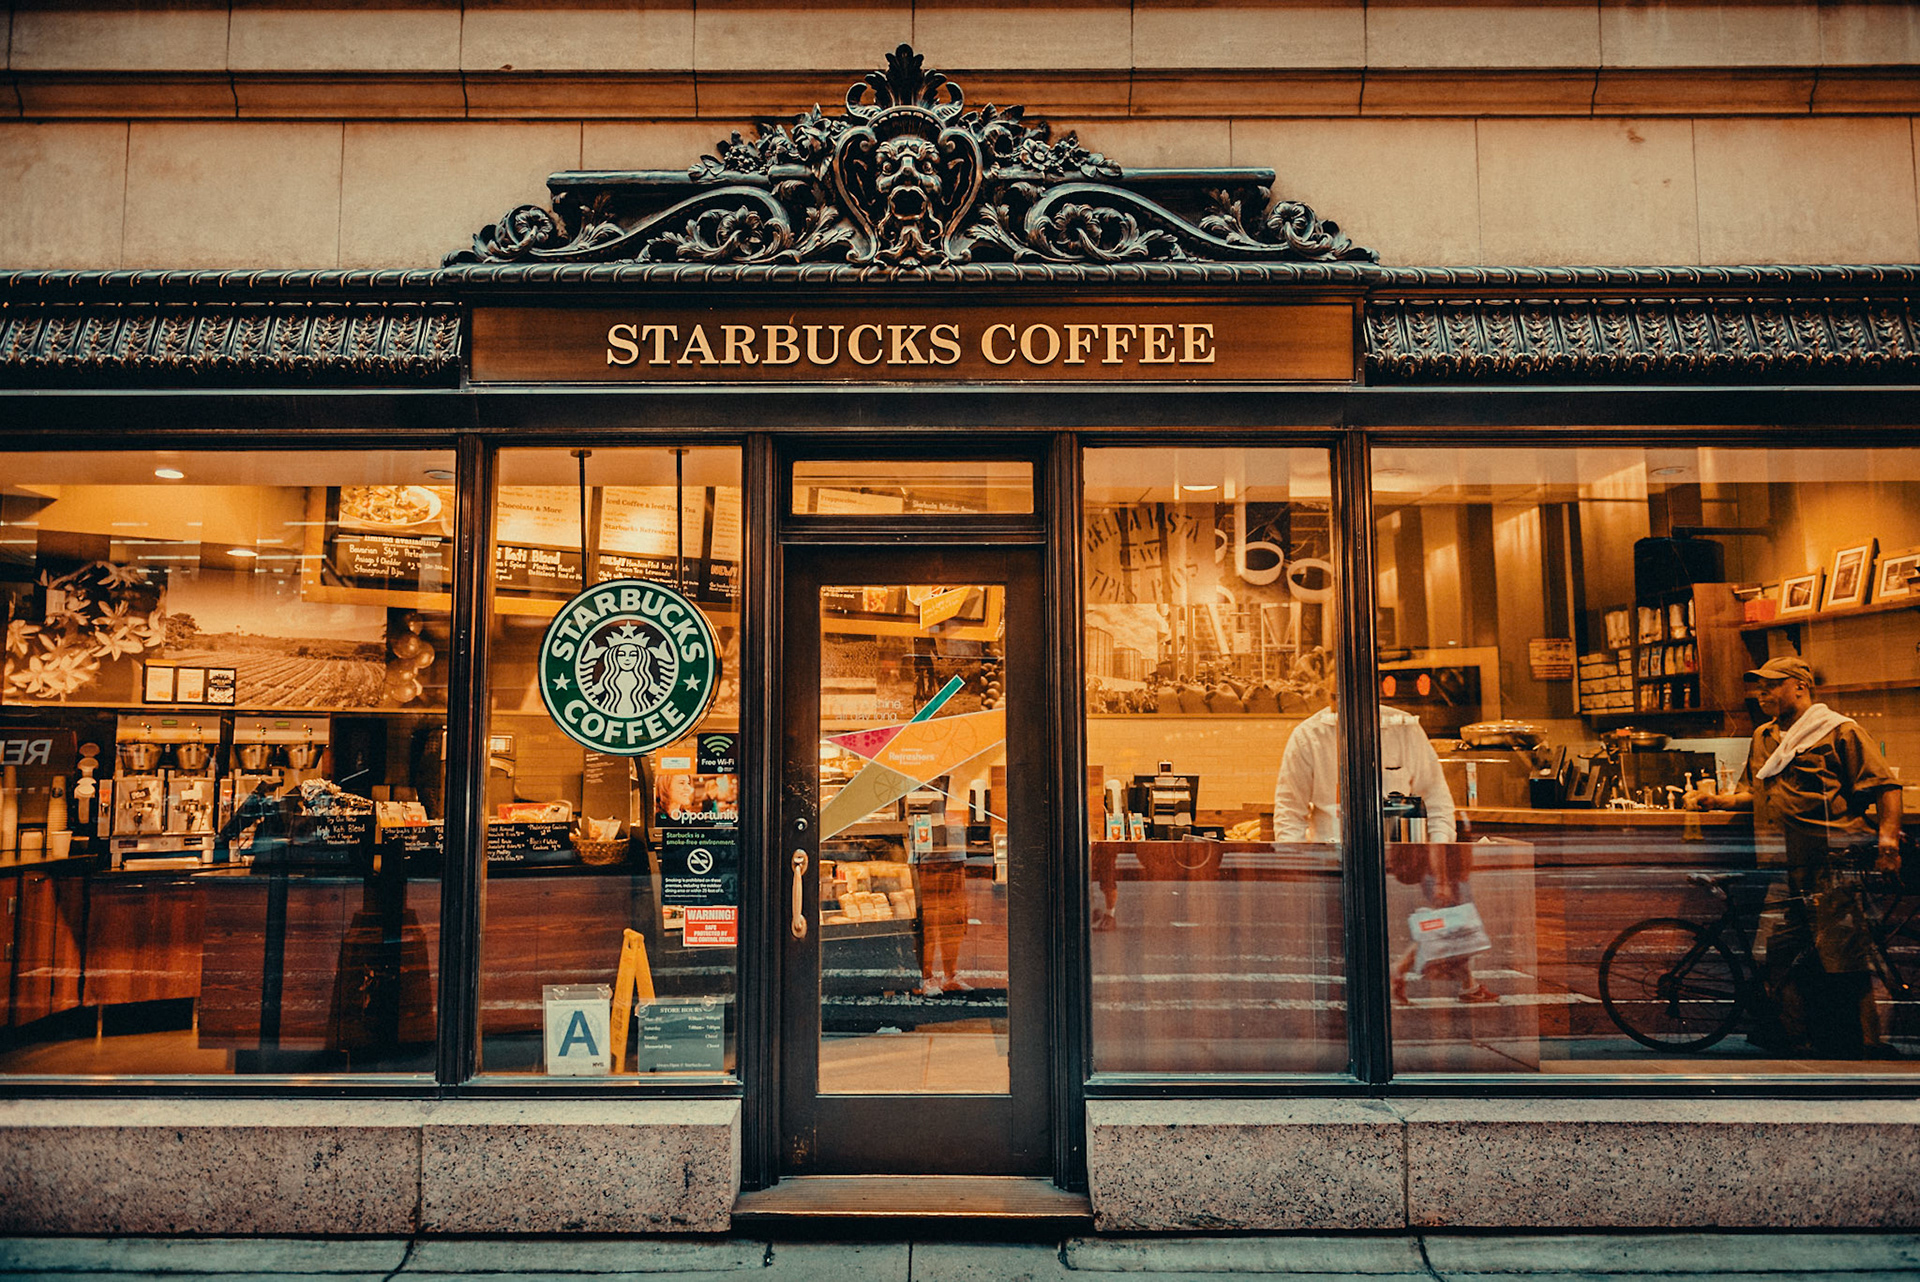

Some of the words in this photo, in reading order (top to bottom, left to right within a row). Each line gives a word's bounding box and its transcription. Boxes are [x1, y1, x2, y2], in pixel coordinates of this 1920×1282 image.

[606, 323, 962, 366] STARBUCKS
[981, 323, 1216, 366] COFFEE
[497, 501, 535, 512] Chocolate
[542, 506, 563, 514] More
[621, 499, 644, 509] Coffee
[684, 506, 696, 514] Tea
[383, 547, 399, 558] Style
[551, 588, 705, 663] STARBUCKS
[564, 699, 685, 745] COFFEE
[701, 758, 716, 766] Free
[717, 758, 735, 766] Wi-Fi
[888, 751, 935, 766] Refreshers
[671, 808, 739, 825] Opportunity
[413, 826, 427, 834] VIA
[666, 831, 694, 839] Starbucks
[686, 909, 735, 921] WARNING!
[558, 1010, 600, 1057] A
